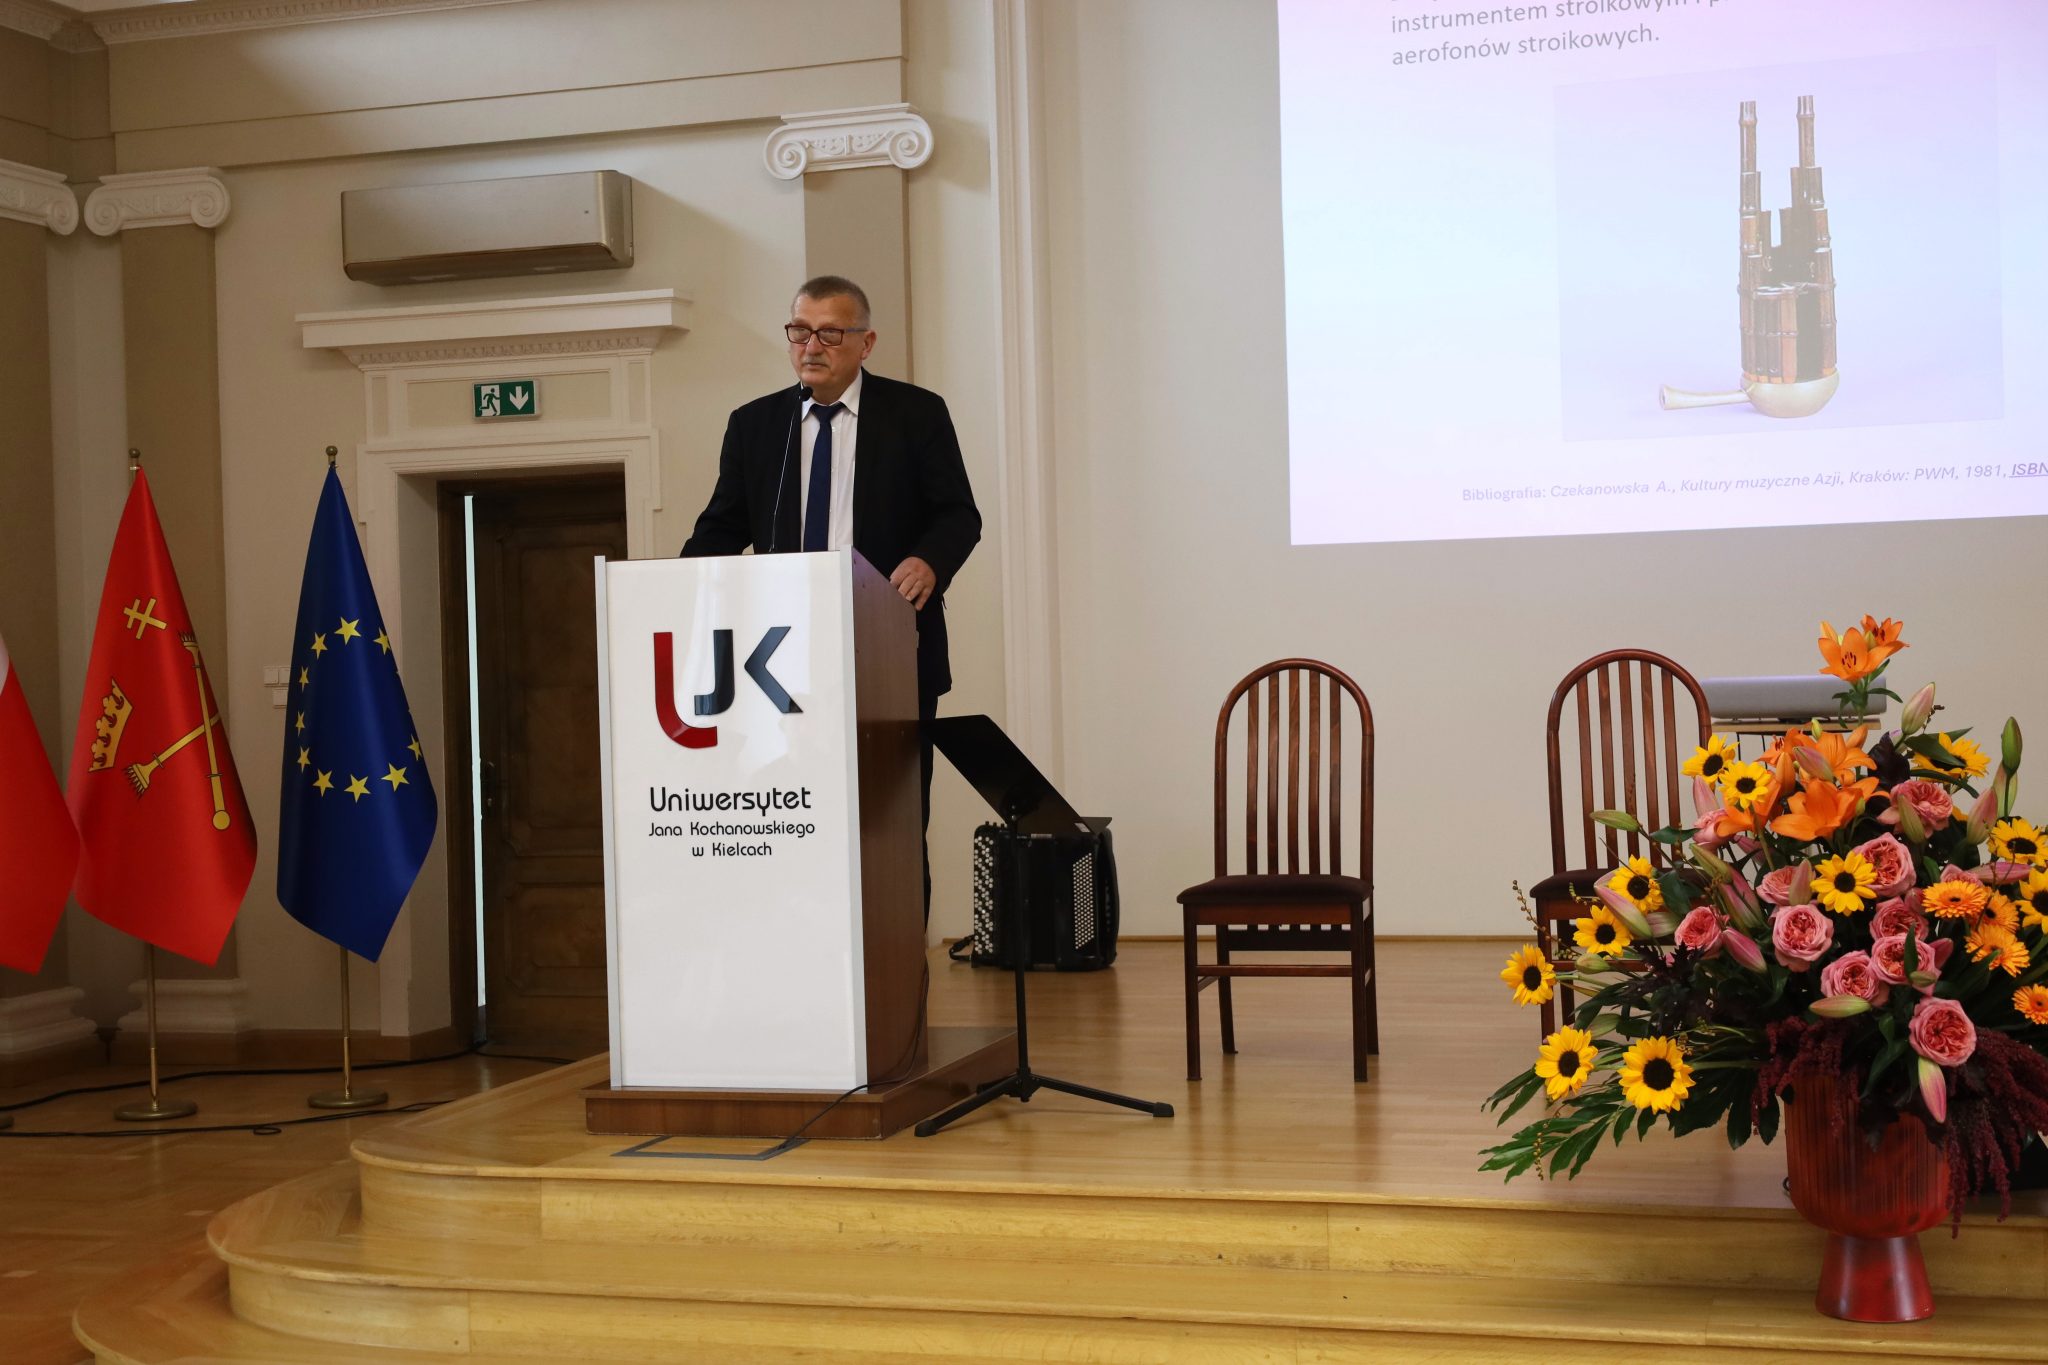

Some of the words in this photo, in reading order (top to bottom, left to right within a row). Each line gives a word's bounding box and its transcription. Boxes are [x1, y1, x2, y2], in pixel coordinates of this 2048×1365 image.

[1392, 5, 1547, 33] instrumentem
[1393, 38, 1511, 65] aerofonów
[1518, 23, 1660, 54] stroikowych.
[1462, 486, 1547, 502] Bibliografia:
[1550, 481, 1649, 498] Czekanowska
[1656, 480, 1676, 494] A.,
[1680, 479, 1733, 493] Kultury
[1735, 474, 1810, 490] muzyczne
[1813, 472, 1845, 487] Azji,
[1849, 468, 1909, 484] Kraków:
[1914, 466, 1959, 481] PWM,
[1965, 463, 2007, 479] 1981,
[650, 786, 812, 817] Uniwersytet
[649, 822, 683, 837] Jana
[690, 820, 816, 838] Kochanowskiego
[691, 847, 705, 857] w
[712, 842, 773, 857] Kielcach
